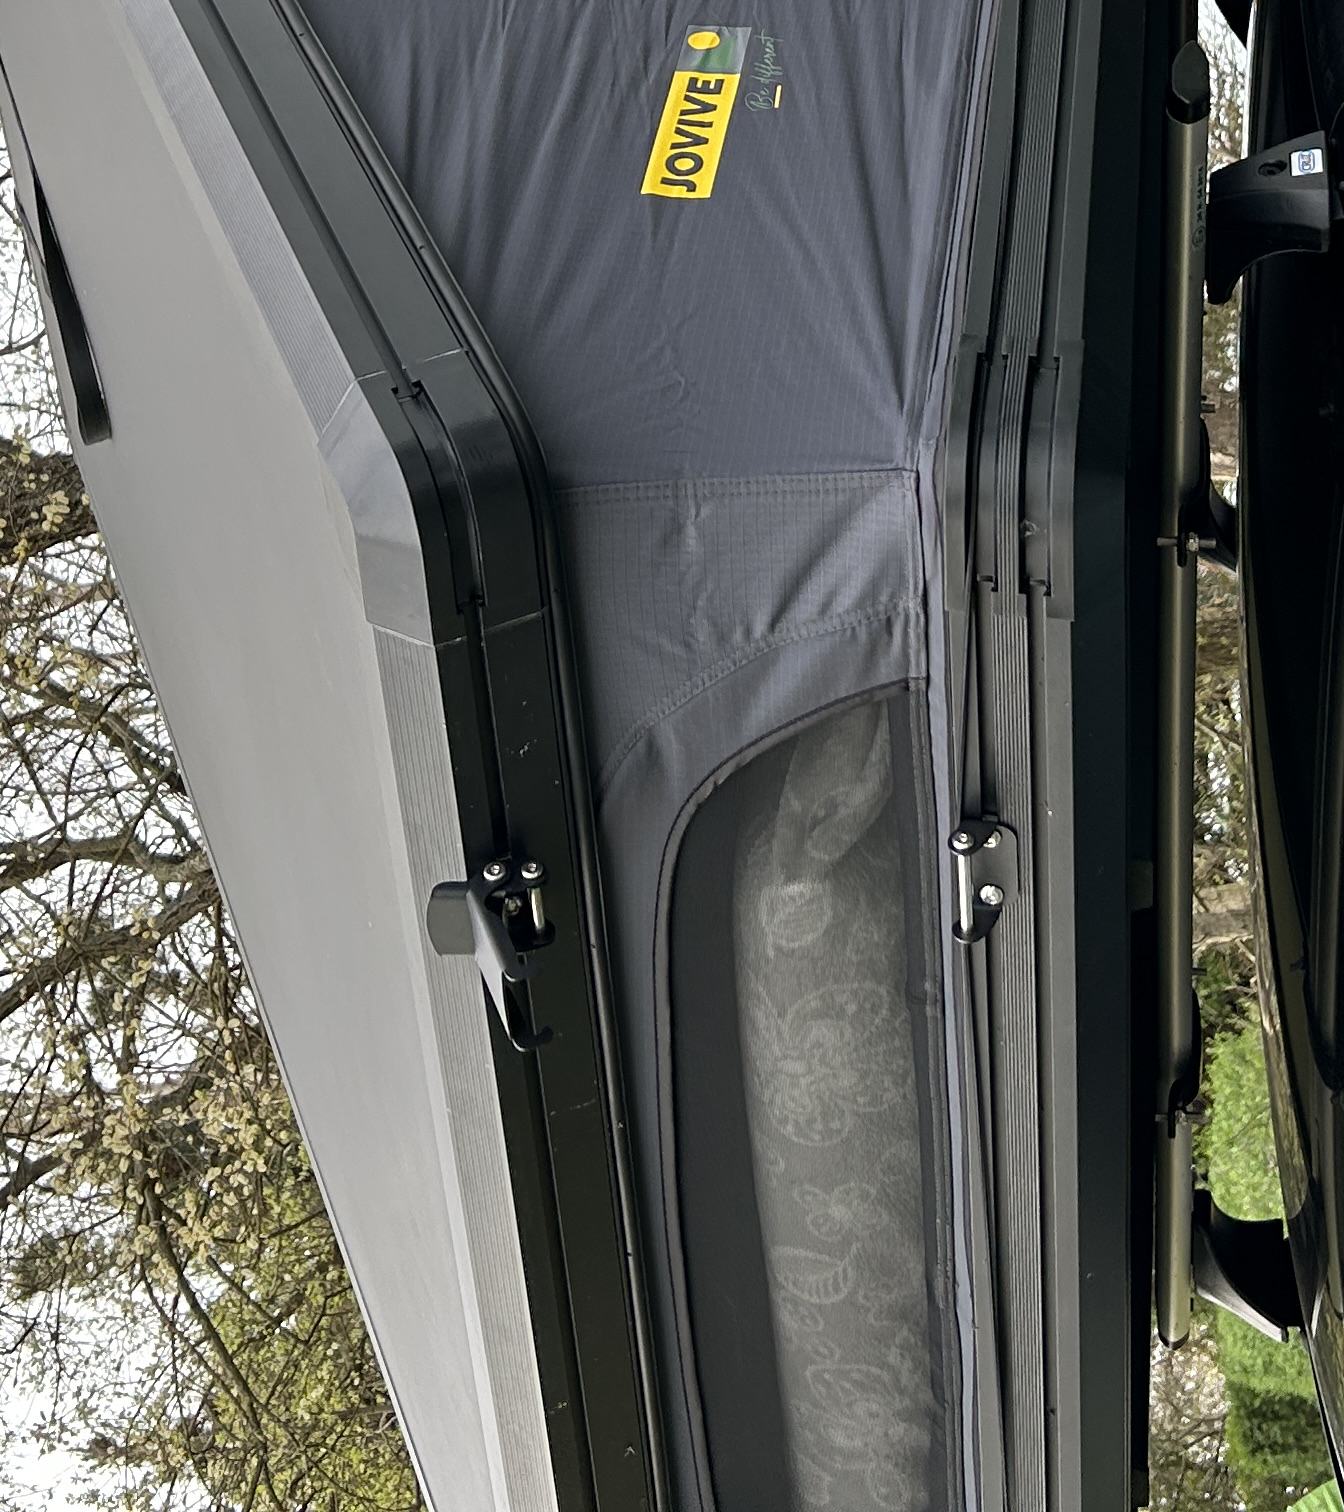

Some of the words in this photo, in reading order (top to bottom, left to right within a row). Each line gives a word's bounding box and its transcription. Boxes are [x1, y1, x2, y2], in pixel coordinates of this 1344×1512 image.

[751, 28, 784, 85] different
[744, 86, 774, 111] Be
[659, 76, 726, 193] JOVIVE
